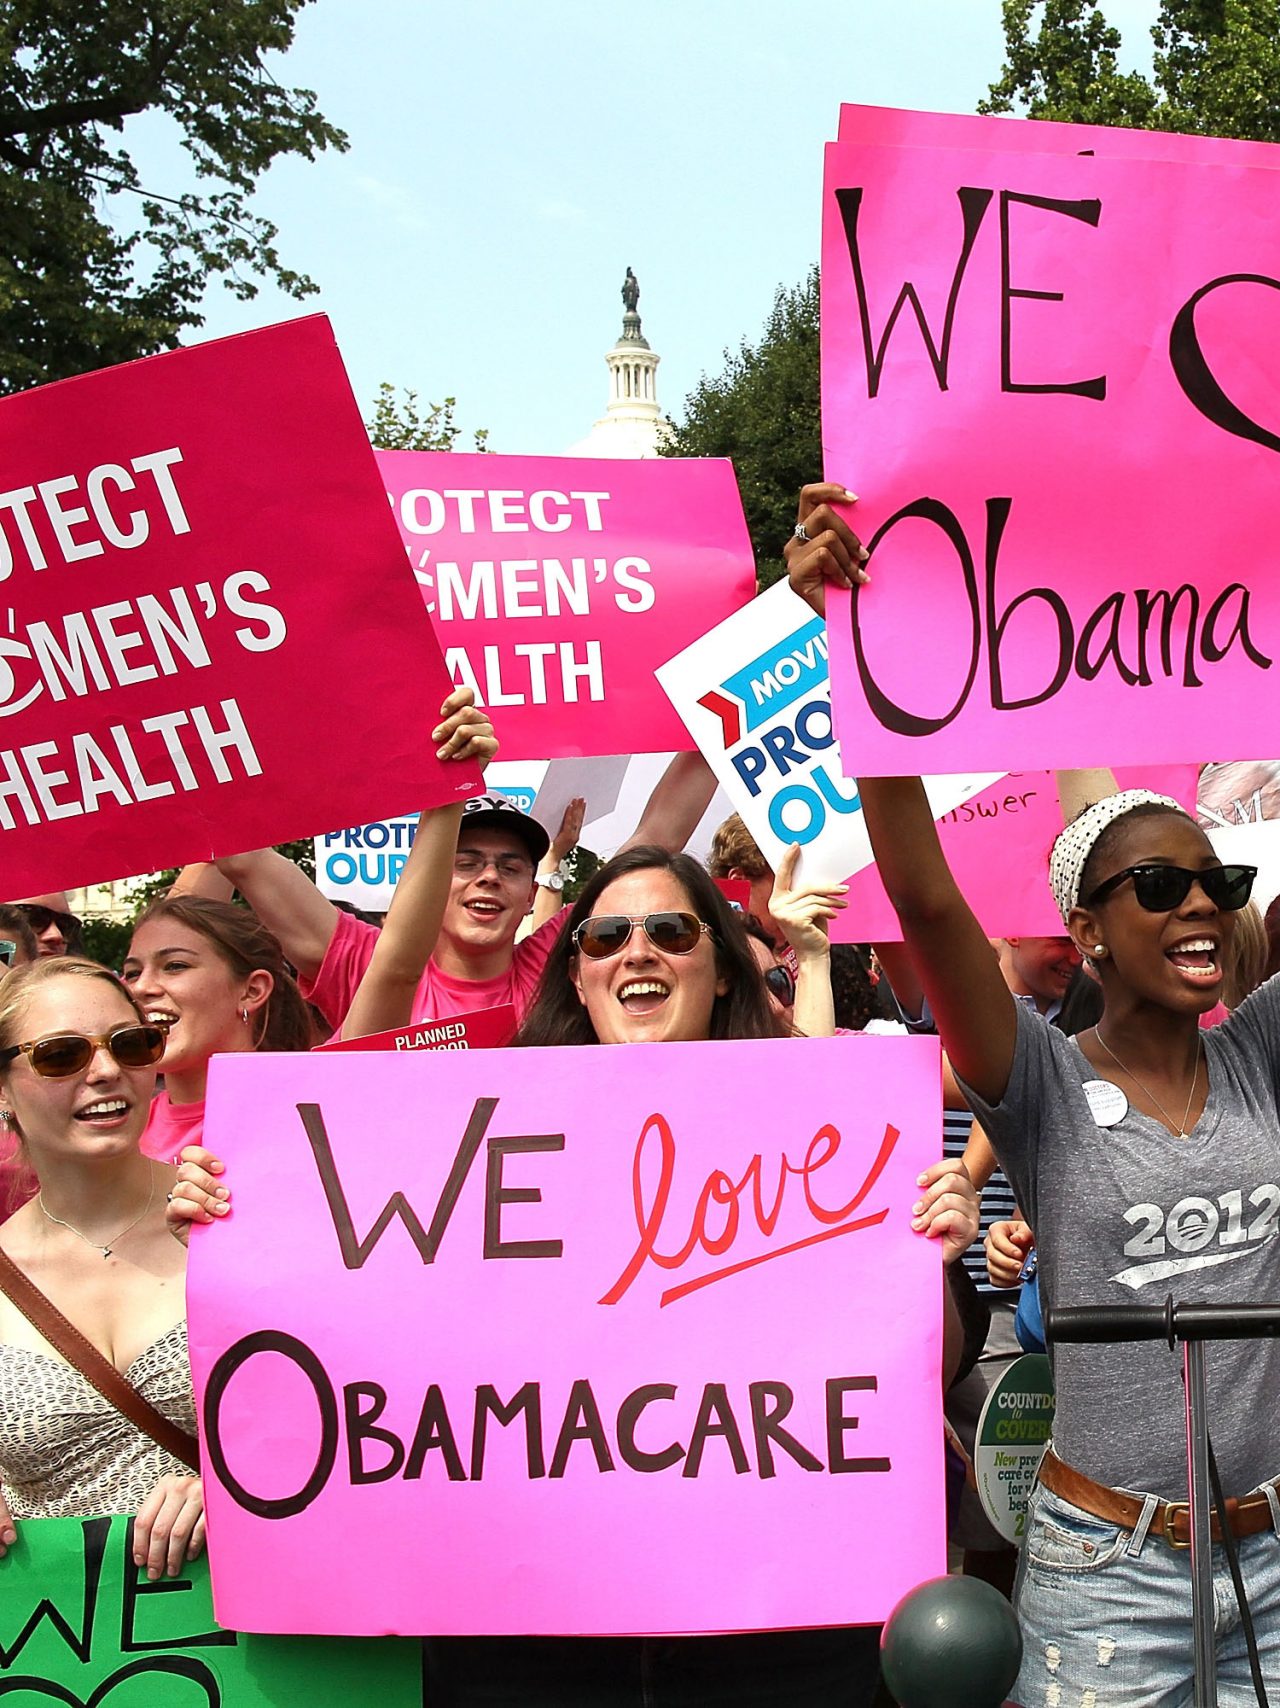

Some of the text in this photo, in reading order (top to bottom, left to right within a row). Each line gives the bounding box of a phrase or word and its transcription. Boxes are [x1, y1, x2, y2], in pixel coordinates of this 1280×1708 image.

[835, 187, 1106, 401] WE
[0, 447, 191, 582] TECT
[389, 488, 611, 536] OTECT
[412, 555, 656, 621] MEN'S
[0, 570, 287, 717] MEN'S
[445, 641, 605, 708] ALTH
[749, 630, 829, 706] MOVI
[0, 698, 263, 831] HEALTH
[326, 853, 408, 885] OUR
[395, 1023, 466, 1051] PLANNED
[295, 1097, 900, 1306] WE love
[204, 1329, 891, 1520] OBAMACARE
[997, 1392, 1056, 1409] COUNTDO
[1011, 1407, 1023, 1419] to
[996, 1419, 1050, 1440] COVER
[994, 1451, 1039, 1469] New pre
[998, 1470, 1022, 1481] care
[1008, 1481, 1023, 1495] for
[1009, 1496, 1028, 1514] beg
